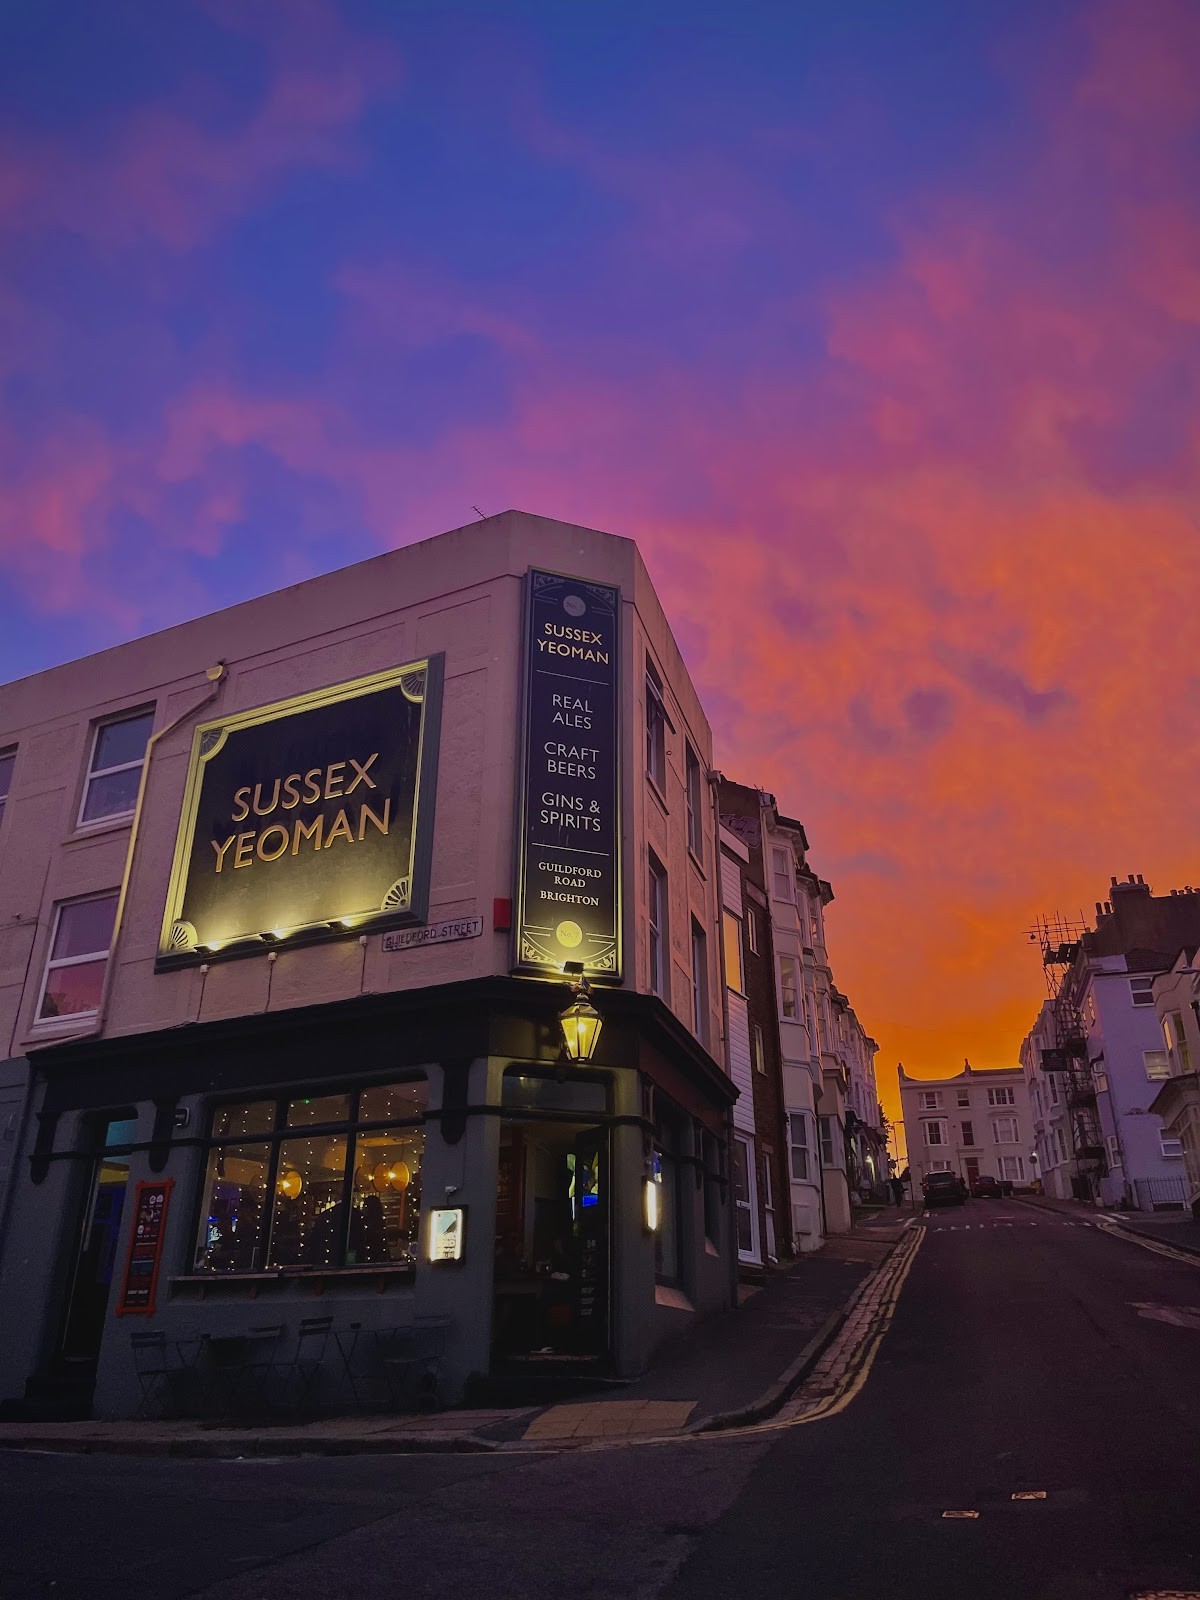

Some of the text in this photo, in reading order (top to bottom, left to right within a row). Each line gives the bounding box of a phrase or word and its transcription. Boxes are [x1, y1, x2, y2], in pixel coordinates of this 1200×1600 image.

[544, 622, 603, 646] SUSSEX
[537, 638, 609, 665] YEOMAN
[552, 693, 593, 713] REAL
[552, 711, 592, 730] ALES
[544, 741, 600, 763] CRAFT
[547, 759, 596, 780] BEERS
[231, 752, 379, 822] SUSSEX
[541, 792, 601, 814] GINS &
[540, 809, 601, 832] SPIRITS
[210, 798, 391, 873] YEOMAN
[538, 861, 602, 879] GUILDFORD
[554, 875, 586, 888] ROAD
[540, 890, 600, 907] BRIGHTON
[386, 921, 479, 947] GUILDFORD STREET
